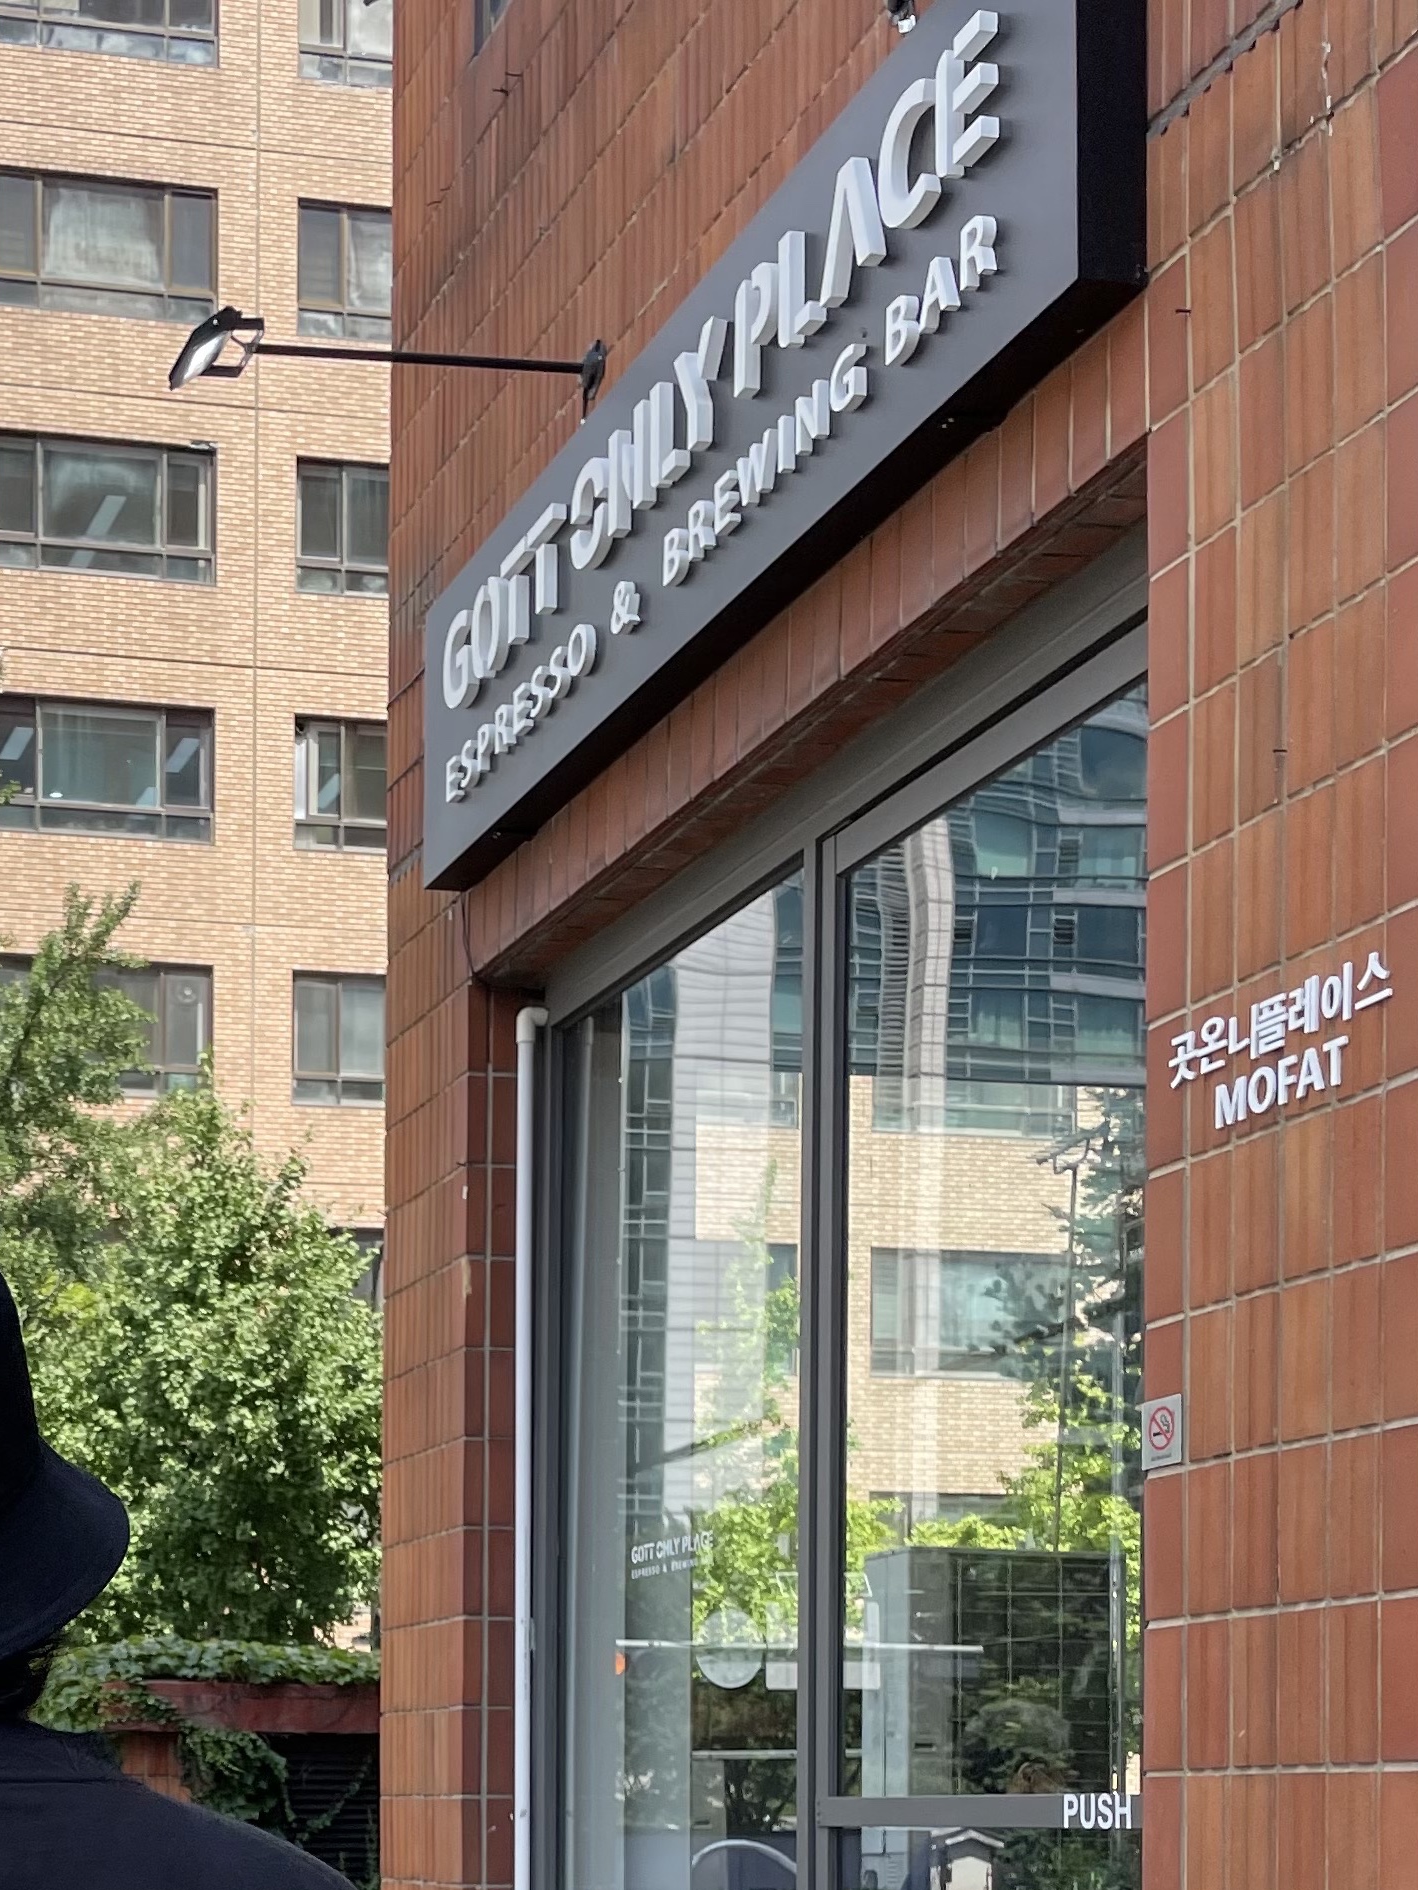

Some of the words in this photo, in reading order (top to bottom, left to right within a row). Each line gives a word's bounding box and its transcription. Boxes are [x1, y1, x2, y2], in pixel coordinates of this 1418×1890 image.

[733, 9, 1000, 400] PLACE
[445, 623, 597, 803] ESPRESSO
[610, 580, 641, 635] &
[662, 343, 868, 587] BREWING
[884, 215, 998, 366] BAR
[1214, 1035, 1350, 1130] MOFAT
[1063, 1793, 1132, 1829] PUSH
